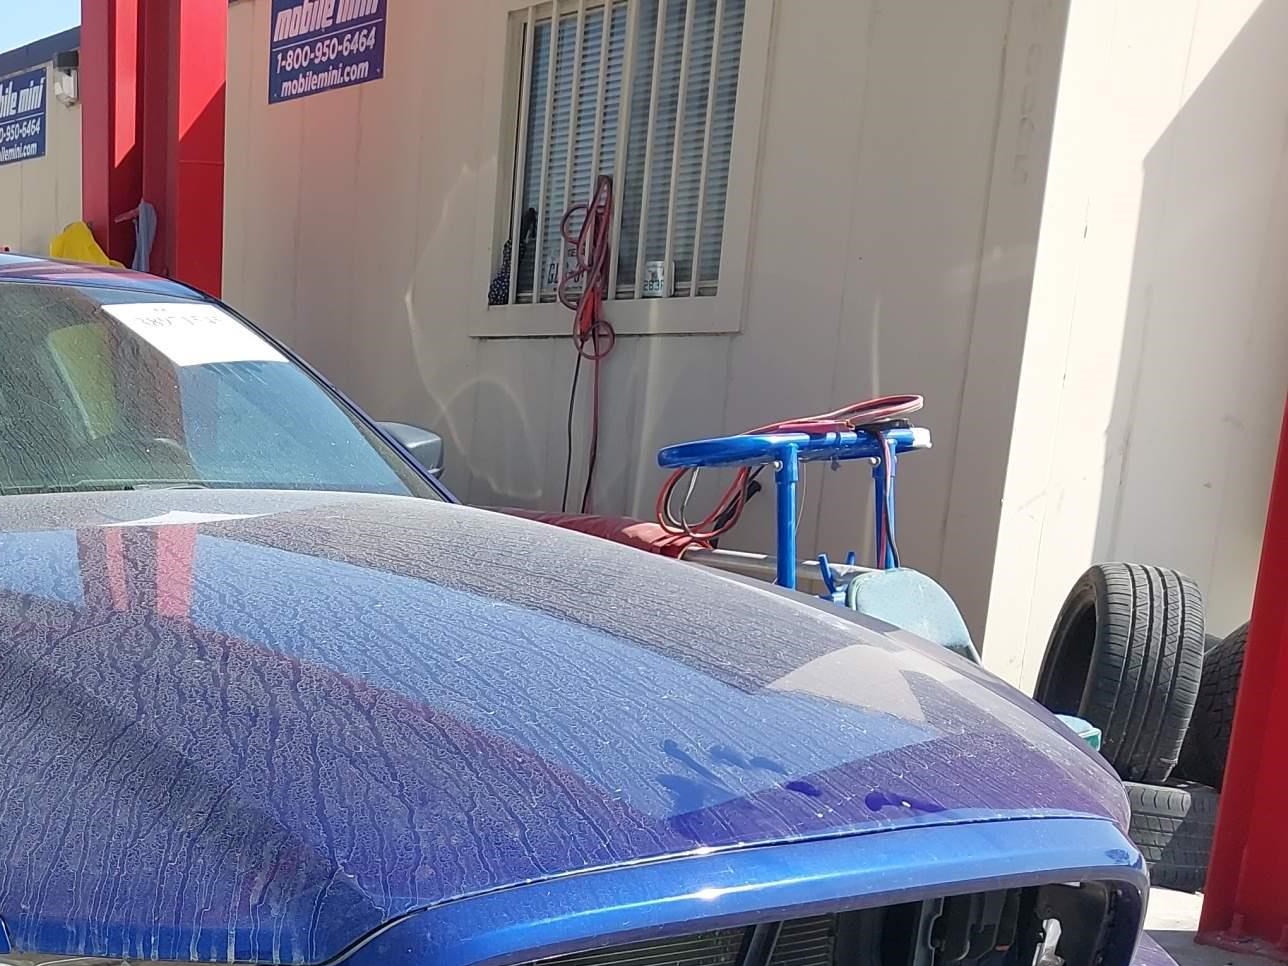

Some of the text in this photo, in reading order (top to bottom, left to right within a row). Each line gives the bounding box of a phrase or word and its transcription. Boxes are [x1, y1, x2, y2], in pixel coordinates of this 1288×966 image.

[273, 0, 335, 42] mobile
[276, 26, 376, 74] 1-800-950-6464
[18, 77, 46, 113] mini
[280, 61, 369, 97] mobilemini.com
